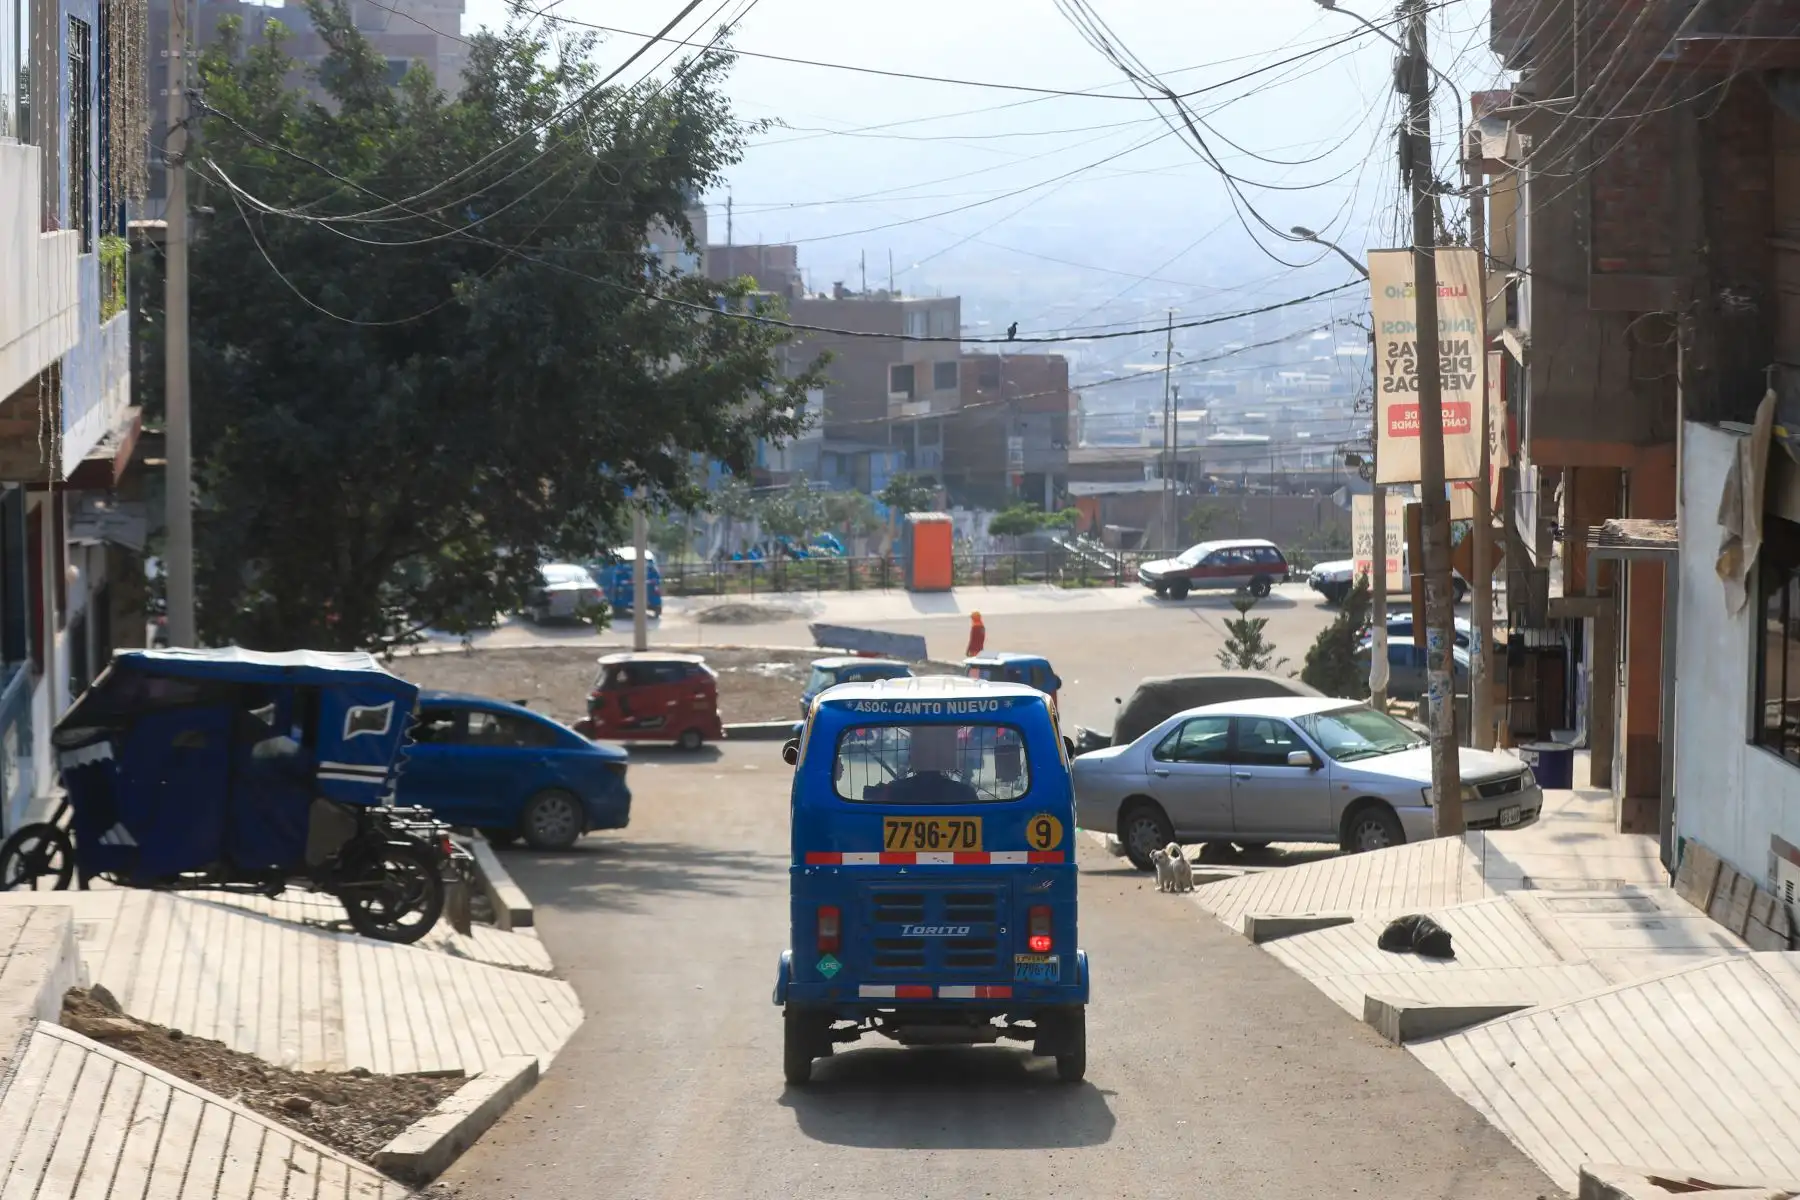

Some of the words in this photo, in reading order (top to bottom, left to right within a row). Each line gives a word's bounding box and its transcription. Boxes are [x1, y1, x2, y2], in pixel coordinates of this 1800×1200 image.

[854, 701, 891, 713] ASOC.
[894, 701, 941, 714] CANTO
[947, 700, 998, 714] NUEVO
[886, 821, 977, 849] 7796-7D
[1036, 820, 1051, 848] 9
